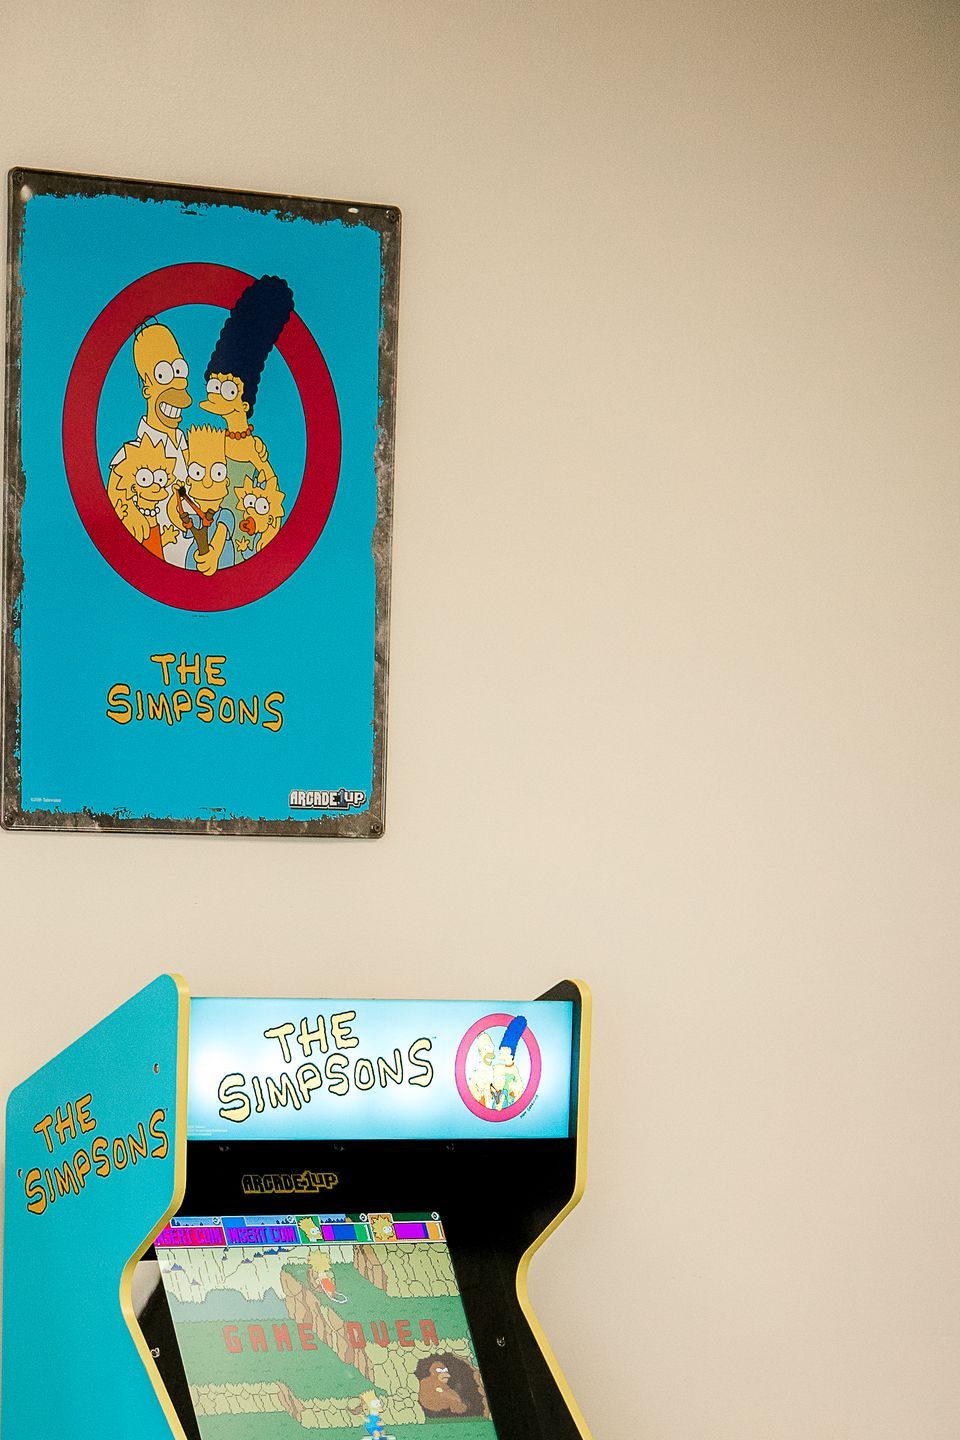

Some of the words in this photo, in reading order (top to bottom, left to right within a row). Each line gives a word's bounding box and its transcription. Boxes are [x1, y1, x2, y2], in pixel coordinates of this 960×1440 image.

[150, 652, 227, 687] THE
[106, 683, 286, 732] SIMPSONS
[263, 1010, 359, 1063] THE
[217, 1037, 435, 1122] SIMPSONS
[32, 1093, 98, 1153] THE
[23, 1108, 169, 1215] SIMPSONS
[158, 1228, 193, 1245] NSERT
[227, 1227, 267, 1244] INSERT
[270, 1226, 297, 1243] COIN
[222, 1323, 318, 1353] GAME
[346, 1319, 440, 1349] OVER
